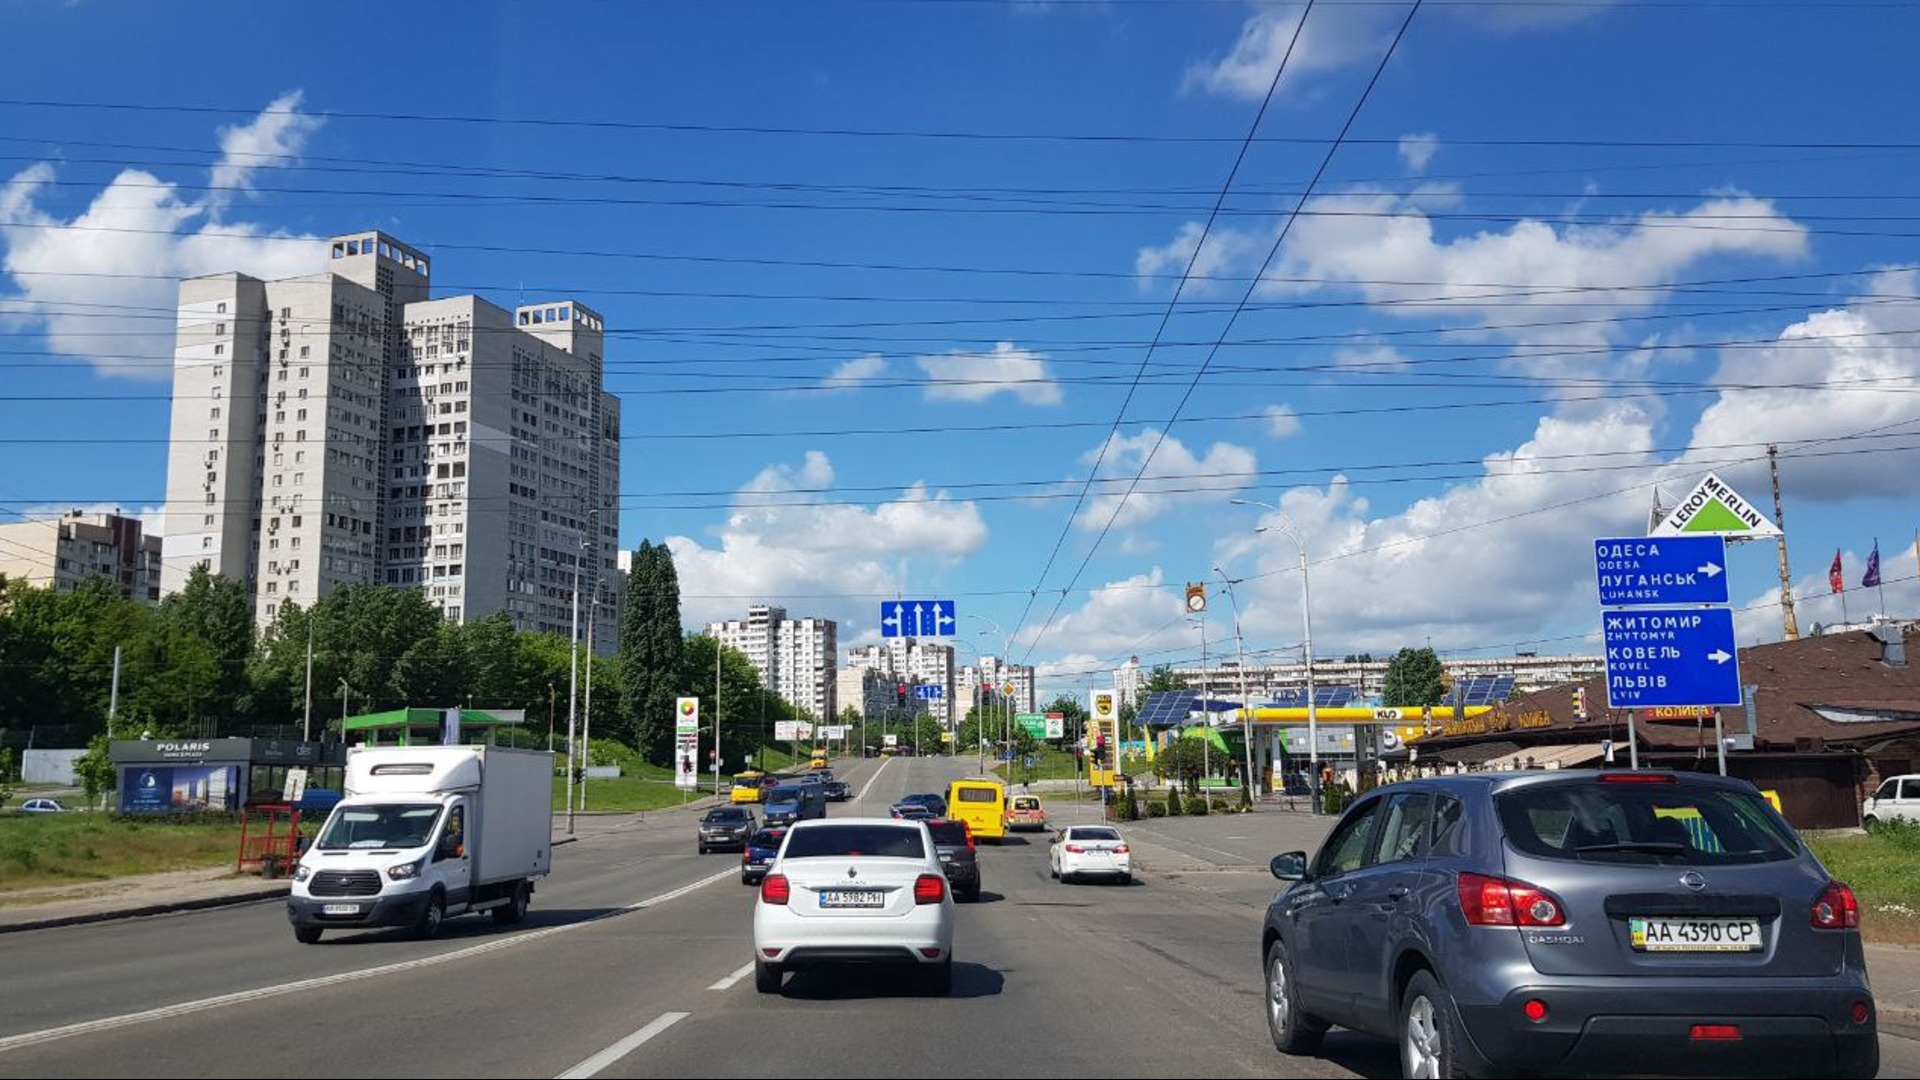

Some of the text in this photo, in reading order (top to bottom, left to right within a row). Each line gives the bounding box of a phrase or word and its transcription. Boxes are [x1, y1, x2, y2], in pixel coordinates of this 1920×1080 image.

[1670, 477, 1762, 529] LEROY MERLIN
[1598, 544, 1659, 558] ОДЕСА
[1599, 561, 1640, 570] ODESA
[1601, 573, 1696, 587] ЛУГАНСЬК
[1601, 590, 1659, 600] LUHANSK
[1607, 616, 1702, 630] ЖИТОМИР
[1607, 632, 1675, 640] ZHYTOMYR
[1609, 646, 1681, 659] КОВЕЛЬ
[1610, 662, 1650, 670] KOVEL
[1612, 675, 1667, 688] ЛЬВІВ
[1377, 710, 1397, 718] KLO
[157, 742, 210, 751] POLARIS
[828, 892, 839, 902] AA
[1646, 922, 1753, 942] AA 4390 CP
